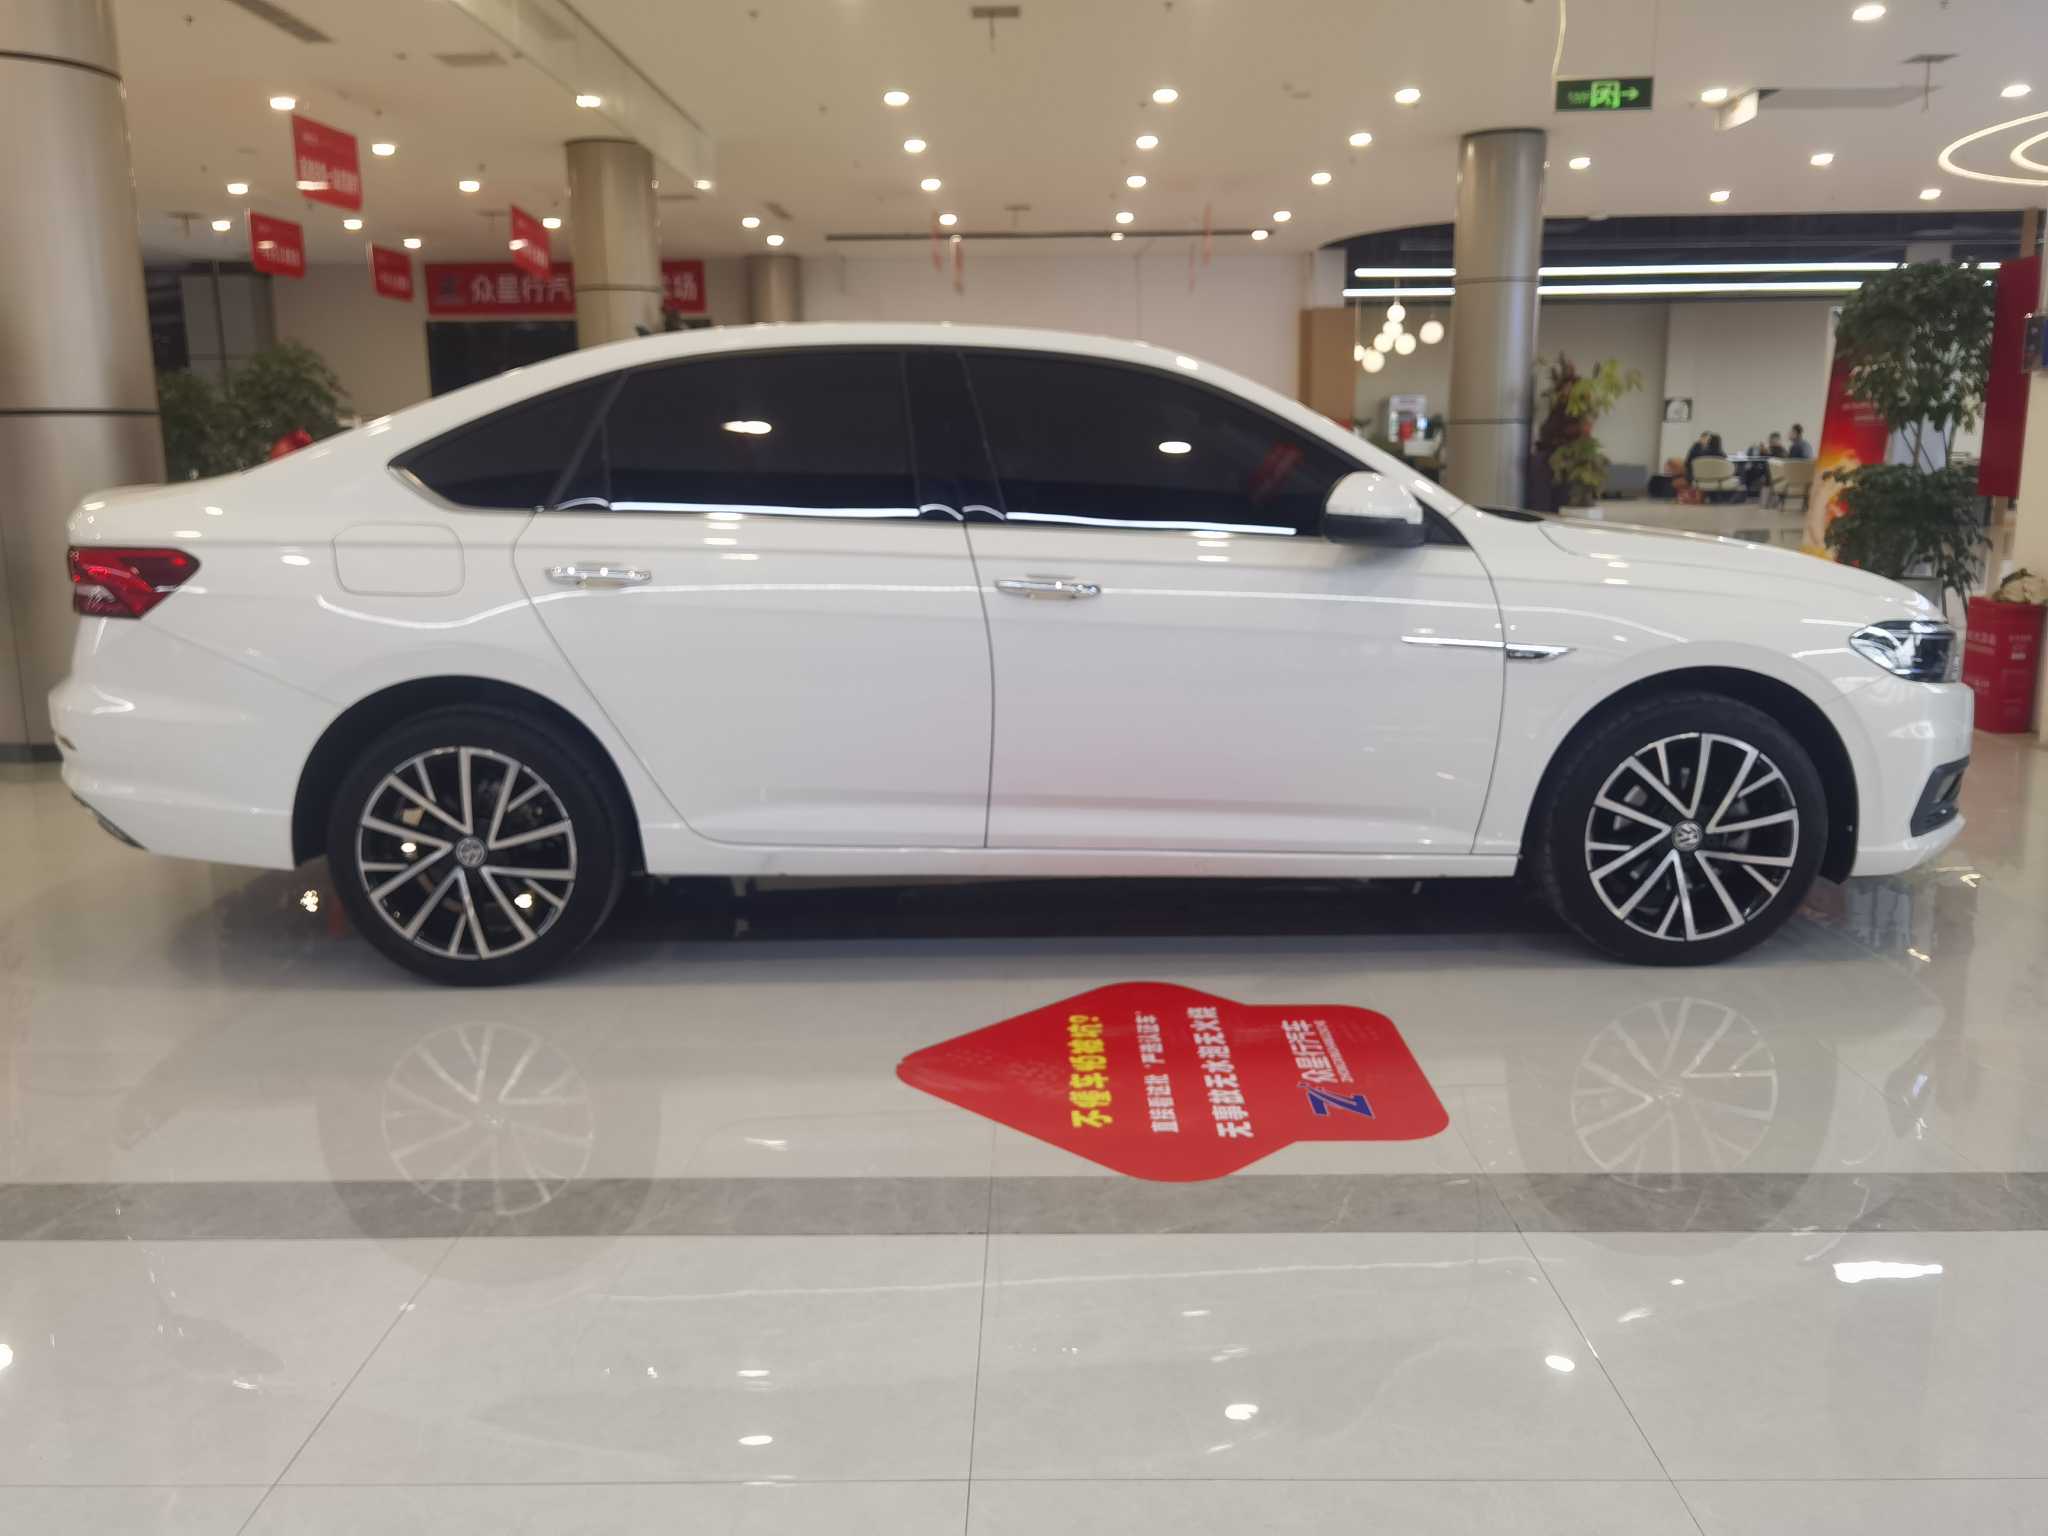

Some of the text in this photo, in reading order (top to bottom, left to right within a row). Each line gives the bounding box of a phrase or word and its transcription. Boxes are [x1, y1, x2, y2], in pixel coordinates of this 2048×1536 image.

[1280, 1018, 1339, 1084] 众星行汽车
